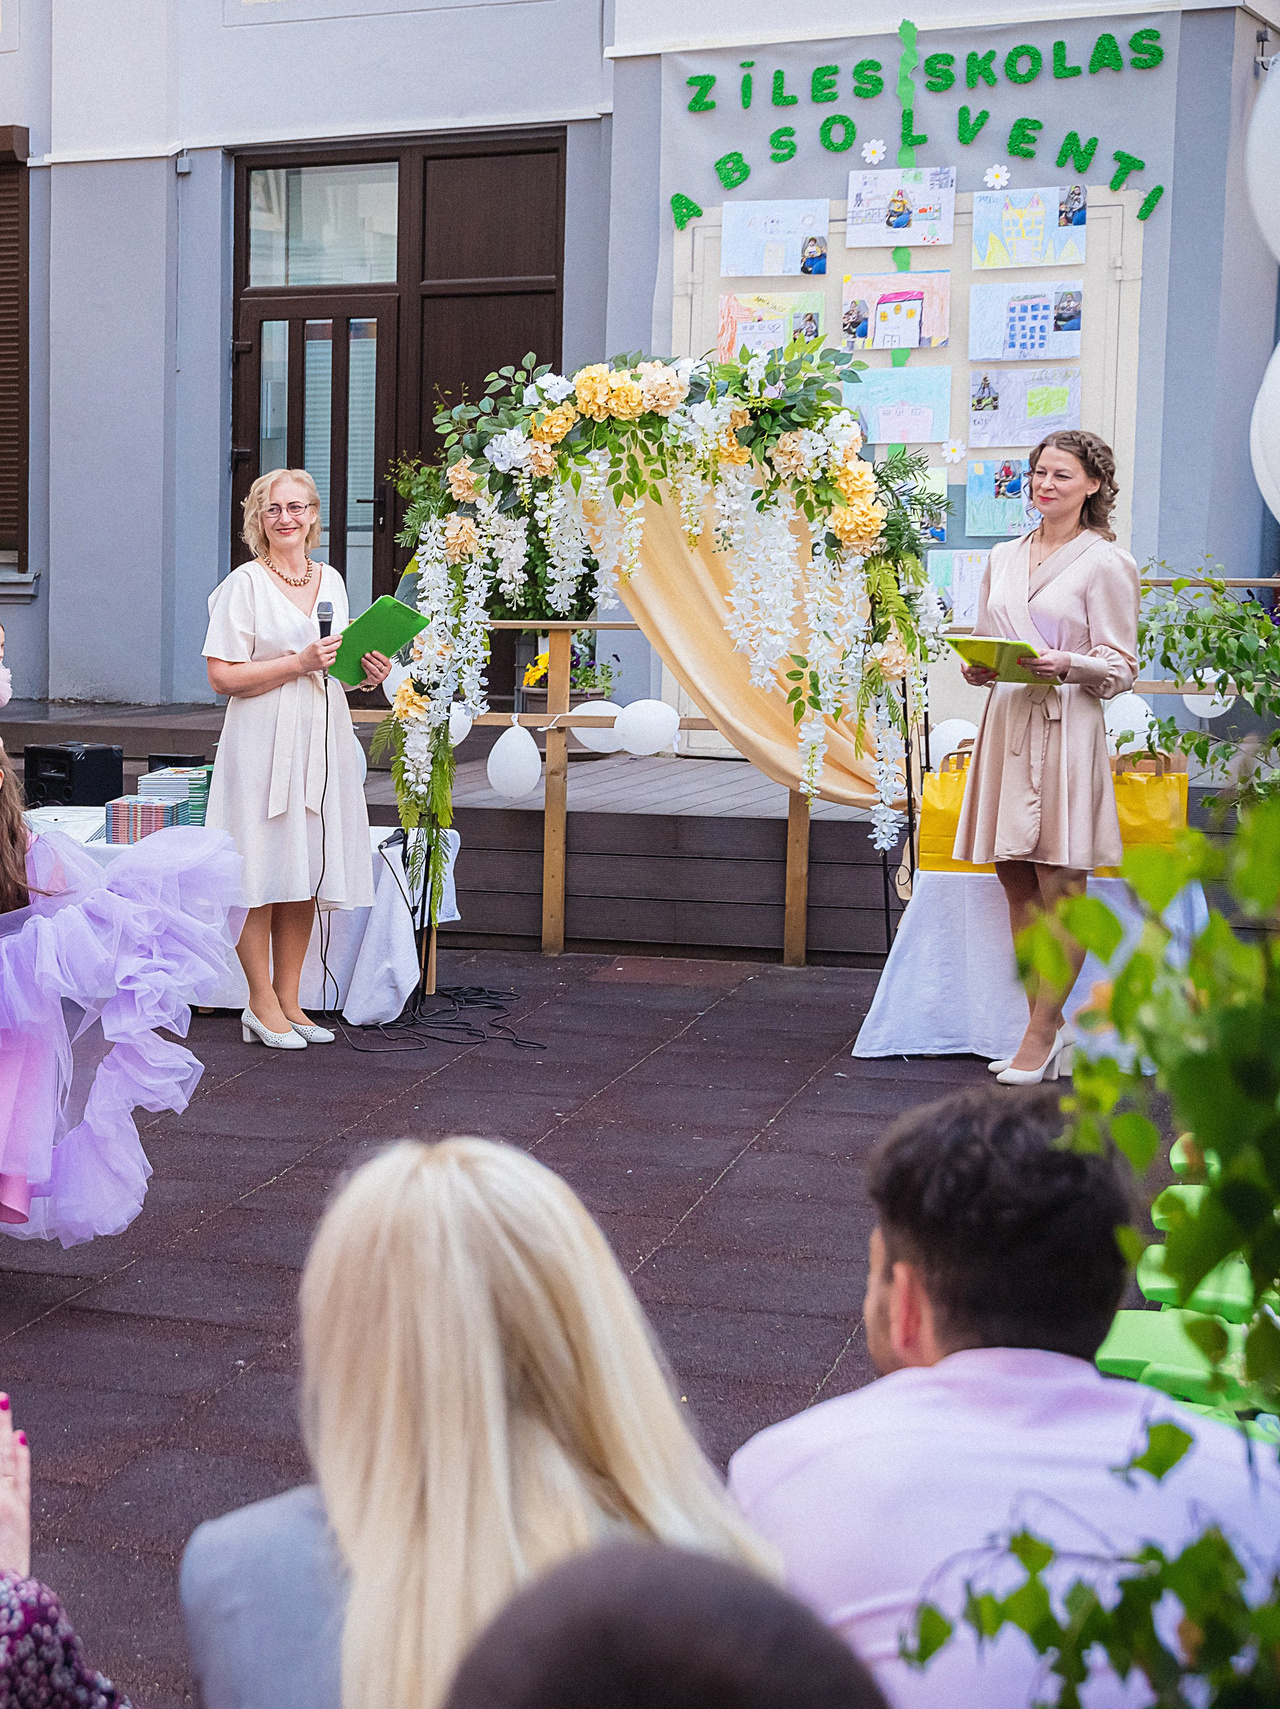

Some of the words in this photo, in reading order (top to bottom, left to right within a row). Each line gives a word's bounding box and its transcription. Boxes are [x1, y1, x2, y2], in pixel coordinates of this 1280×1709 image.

[685, 58, 885, 113] ZĪLES
[923, 28, 1166, 93] SKOLAS
[669, 105, 1165, 232] ABSOLVENTI
